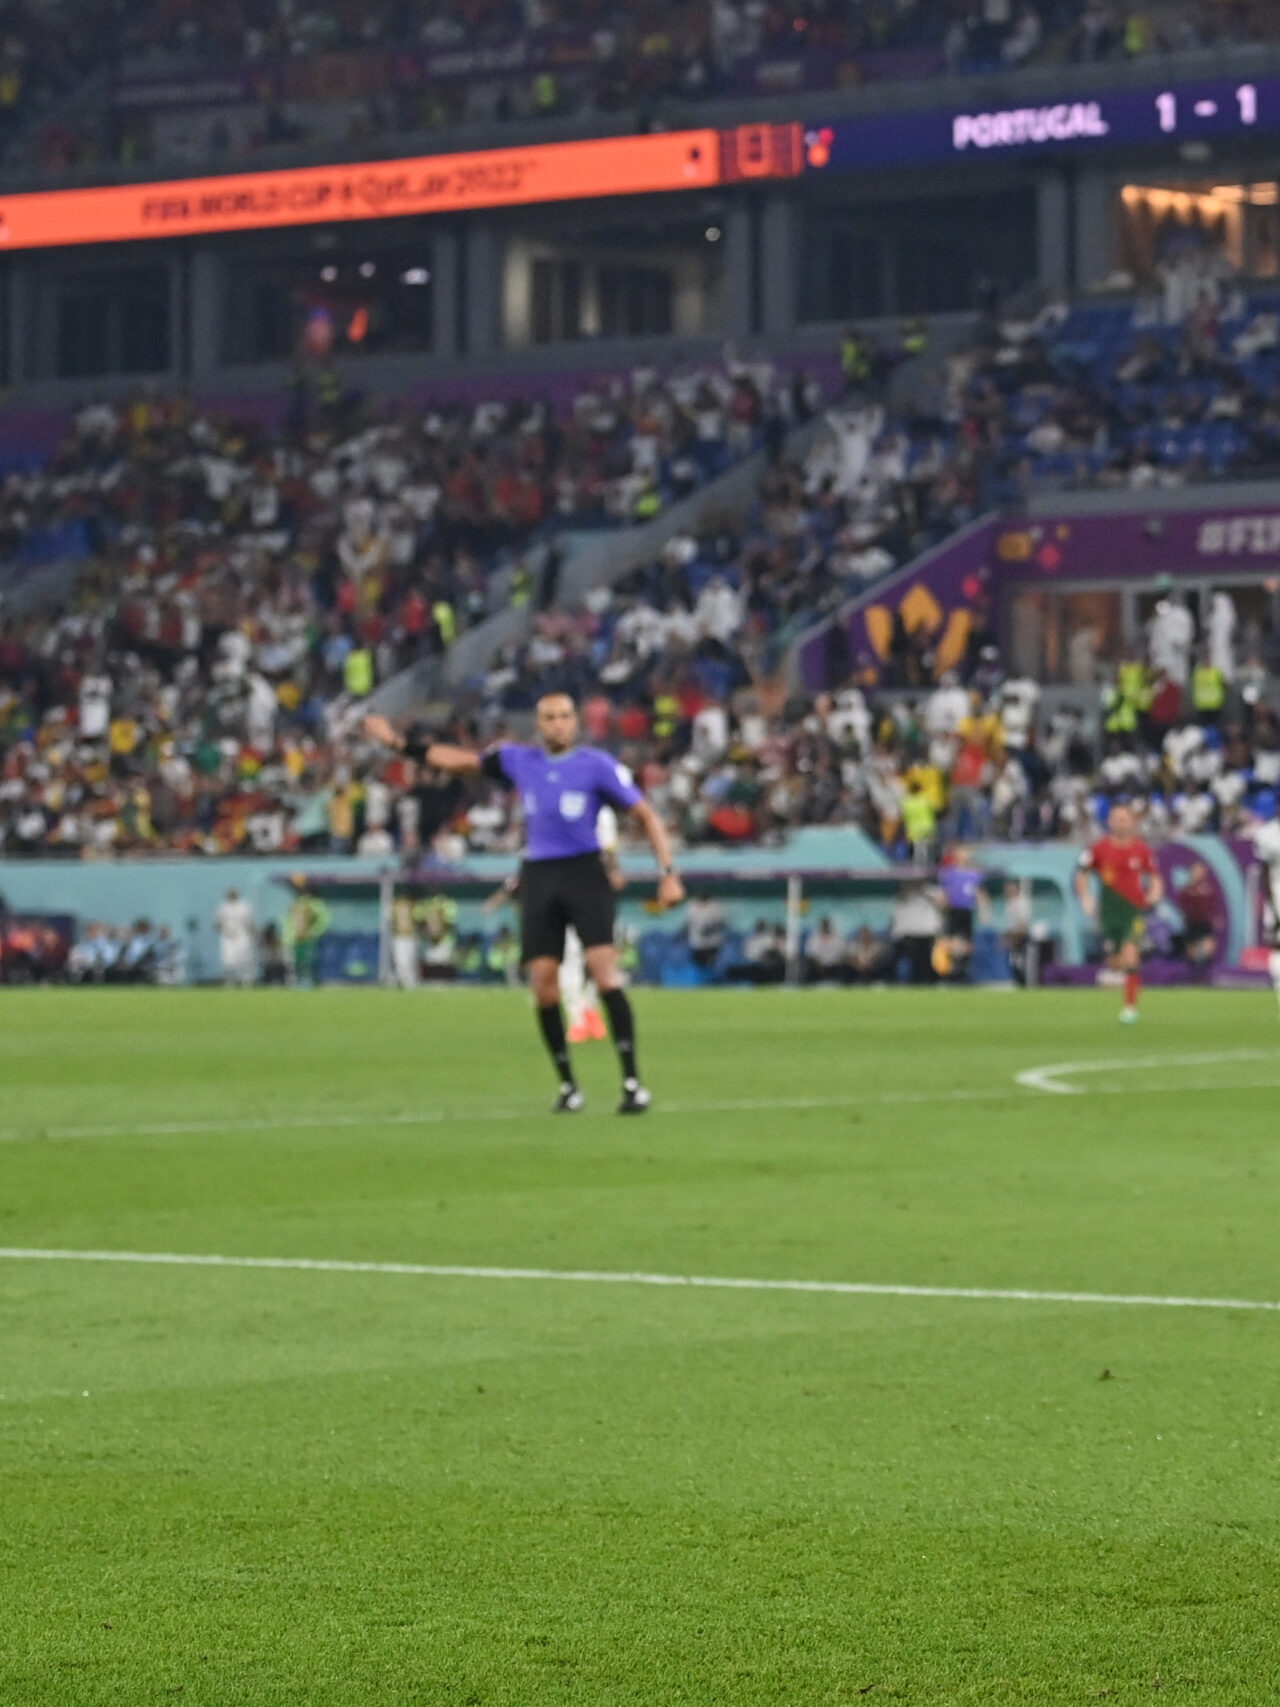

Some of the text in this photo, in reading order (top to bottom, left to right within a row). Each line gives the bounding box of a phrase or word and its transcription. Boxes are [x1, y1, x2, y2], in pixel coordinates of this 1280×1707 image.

[953, 102, 1109, 149] PORTUGAL
[1156, 92, 1176, 132] 1
[1195, 100, 1218, 117] -
[1236, 84, 1257, 124] 1
[142, 197, 190, 221] FIFA
[200, 186, 280, 215] WORLD
